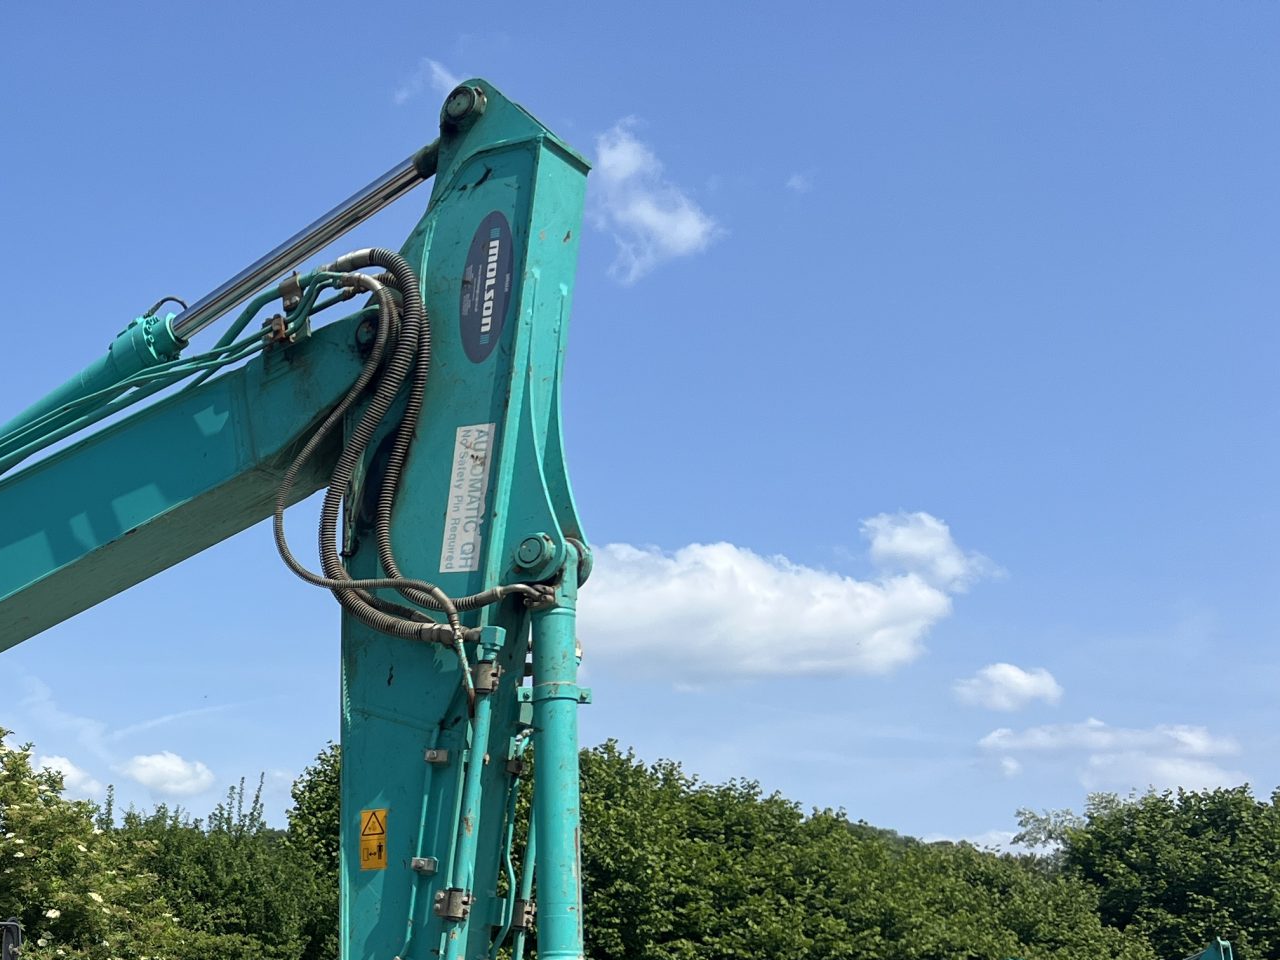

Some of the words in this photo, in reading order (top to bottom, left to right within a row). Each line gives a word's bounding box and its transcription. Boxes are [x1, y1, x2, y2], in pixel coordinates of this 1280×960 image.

[453, 451, 469, 490] Safety
[452, 495, 464, 513] Pin
[444, 518, 461, 570] Required
[458, 542, 476, 569] QH
